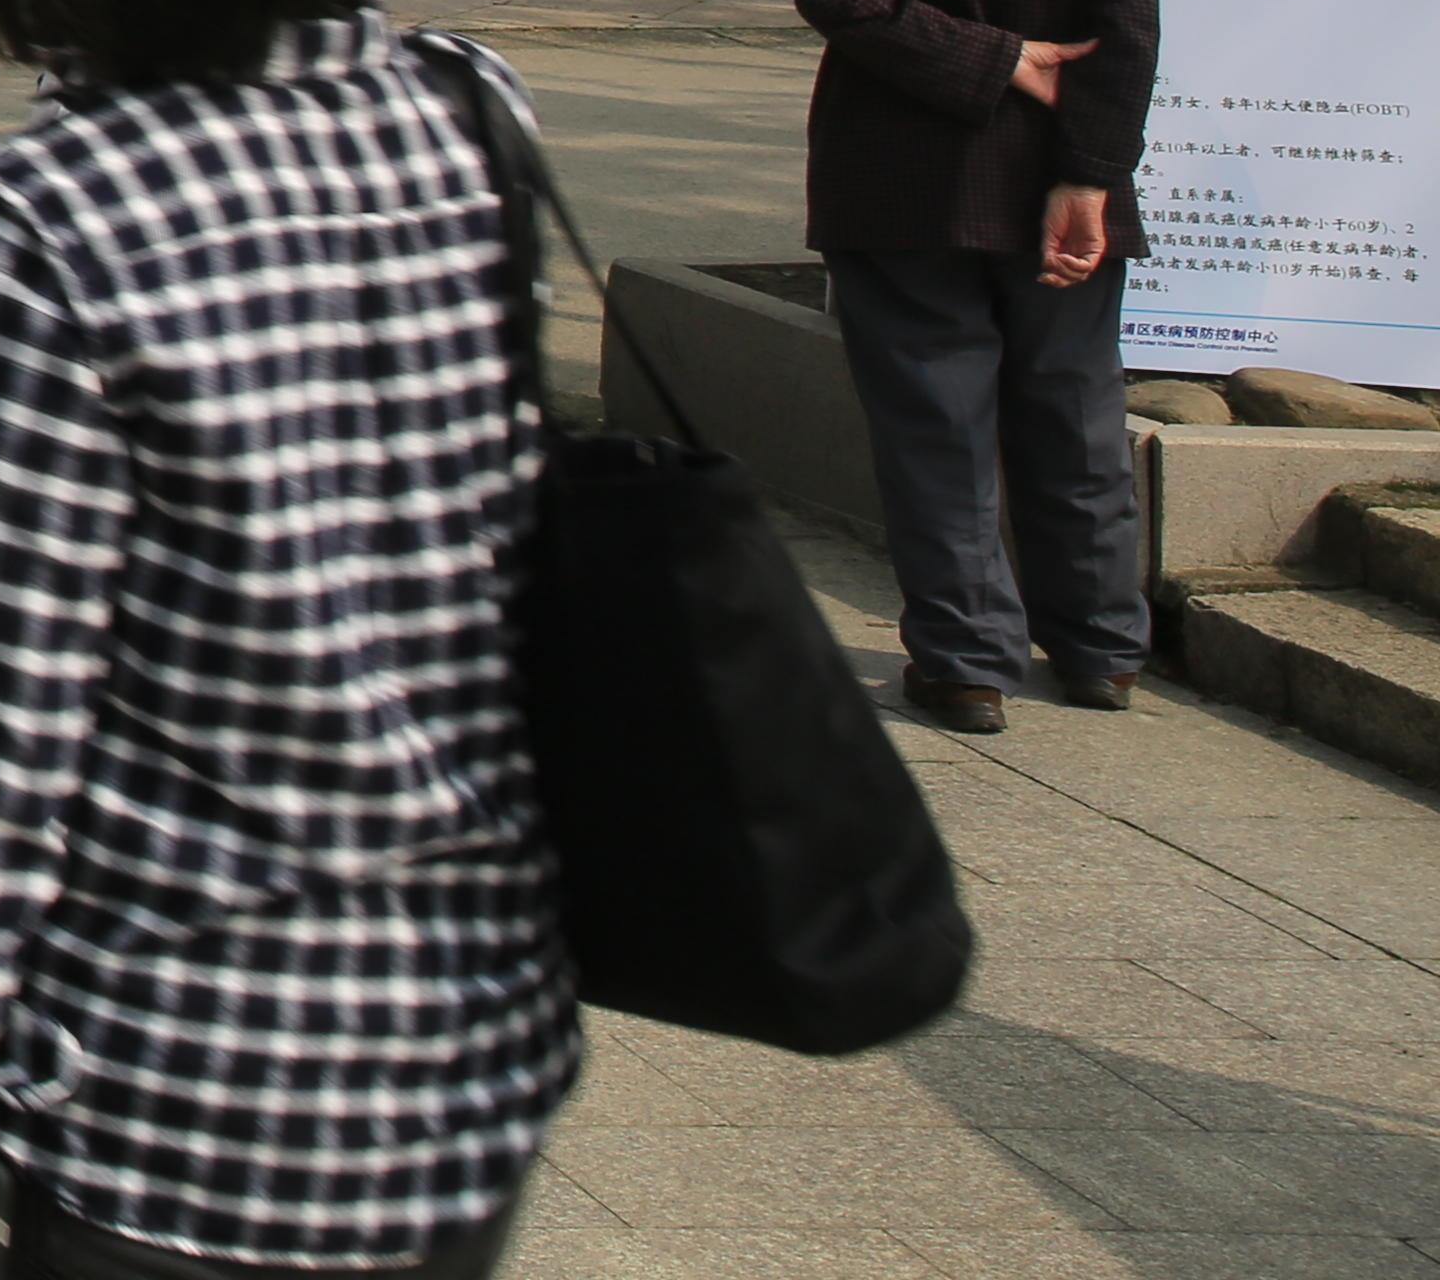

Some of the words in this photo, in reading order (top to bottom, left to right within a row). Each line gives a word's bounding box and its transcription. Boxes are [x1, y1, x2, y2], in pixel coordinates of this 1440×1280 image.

[1146, 141, 1404, 164] 在10年以上者，可继续维持筛查；
[1123, 278, 1169, 293] 肠镜；
